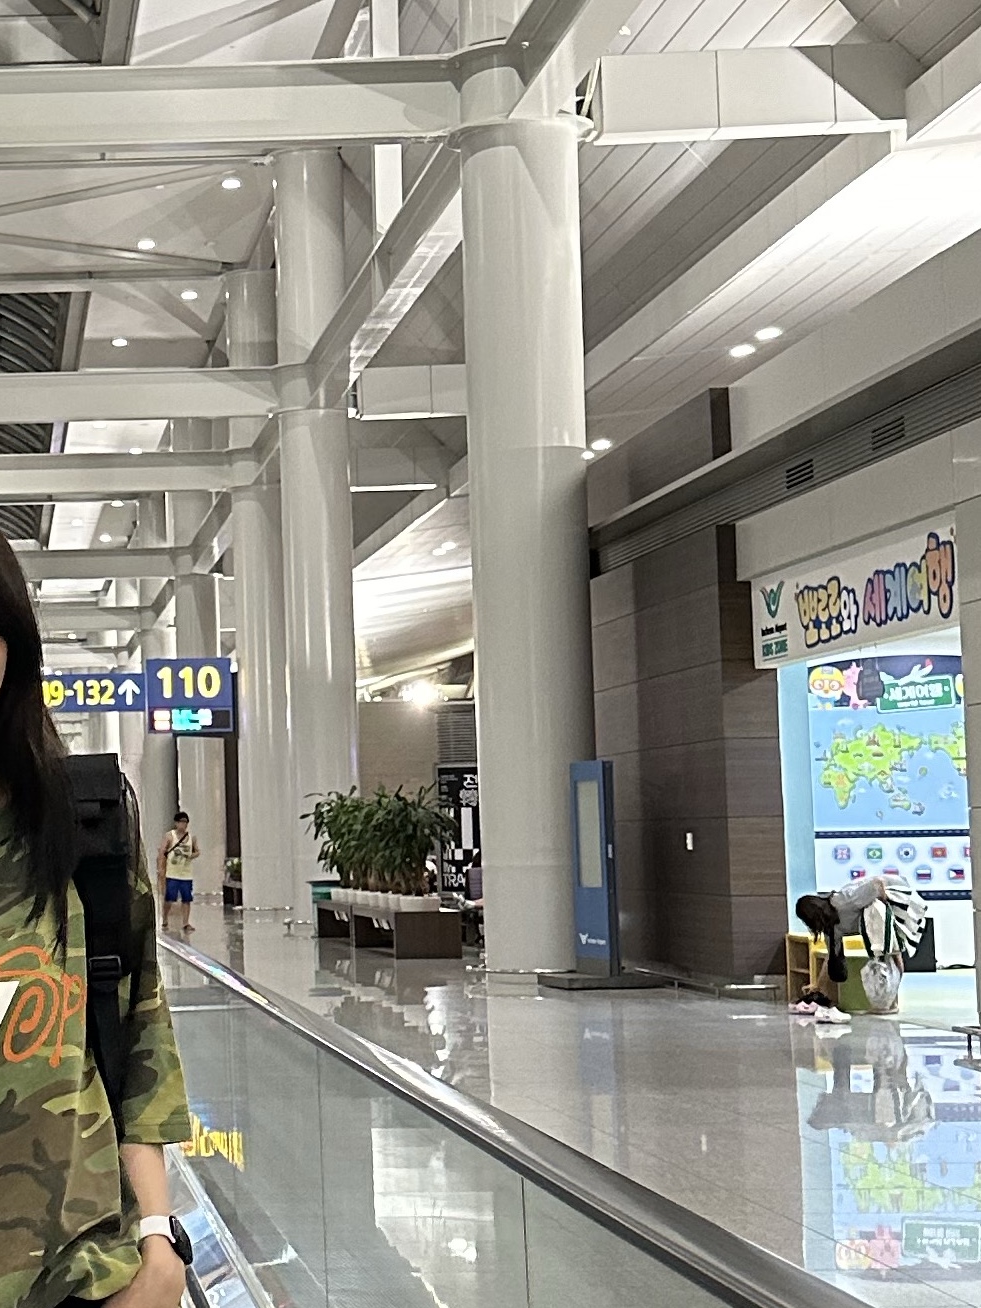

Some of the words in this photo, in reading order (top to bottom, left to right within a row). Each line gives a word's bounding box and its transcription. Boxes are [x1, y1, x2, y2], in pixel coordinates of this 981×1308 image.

[798, 576, 859, 648] 뽀로로와
[863, 532, 955, 627] 세계여행
[157, 665, 221, 698] 110
